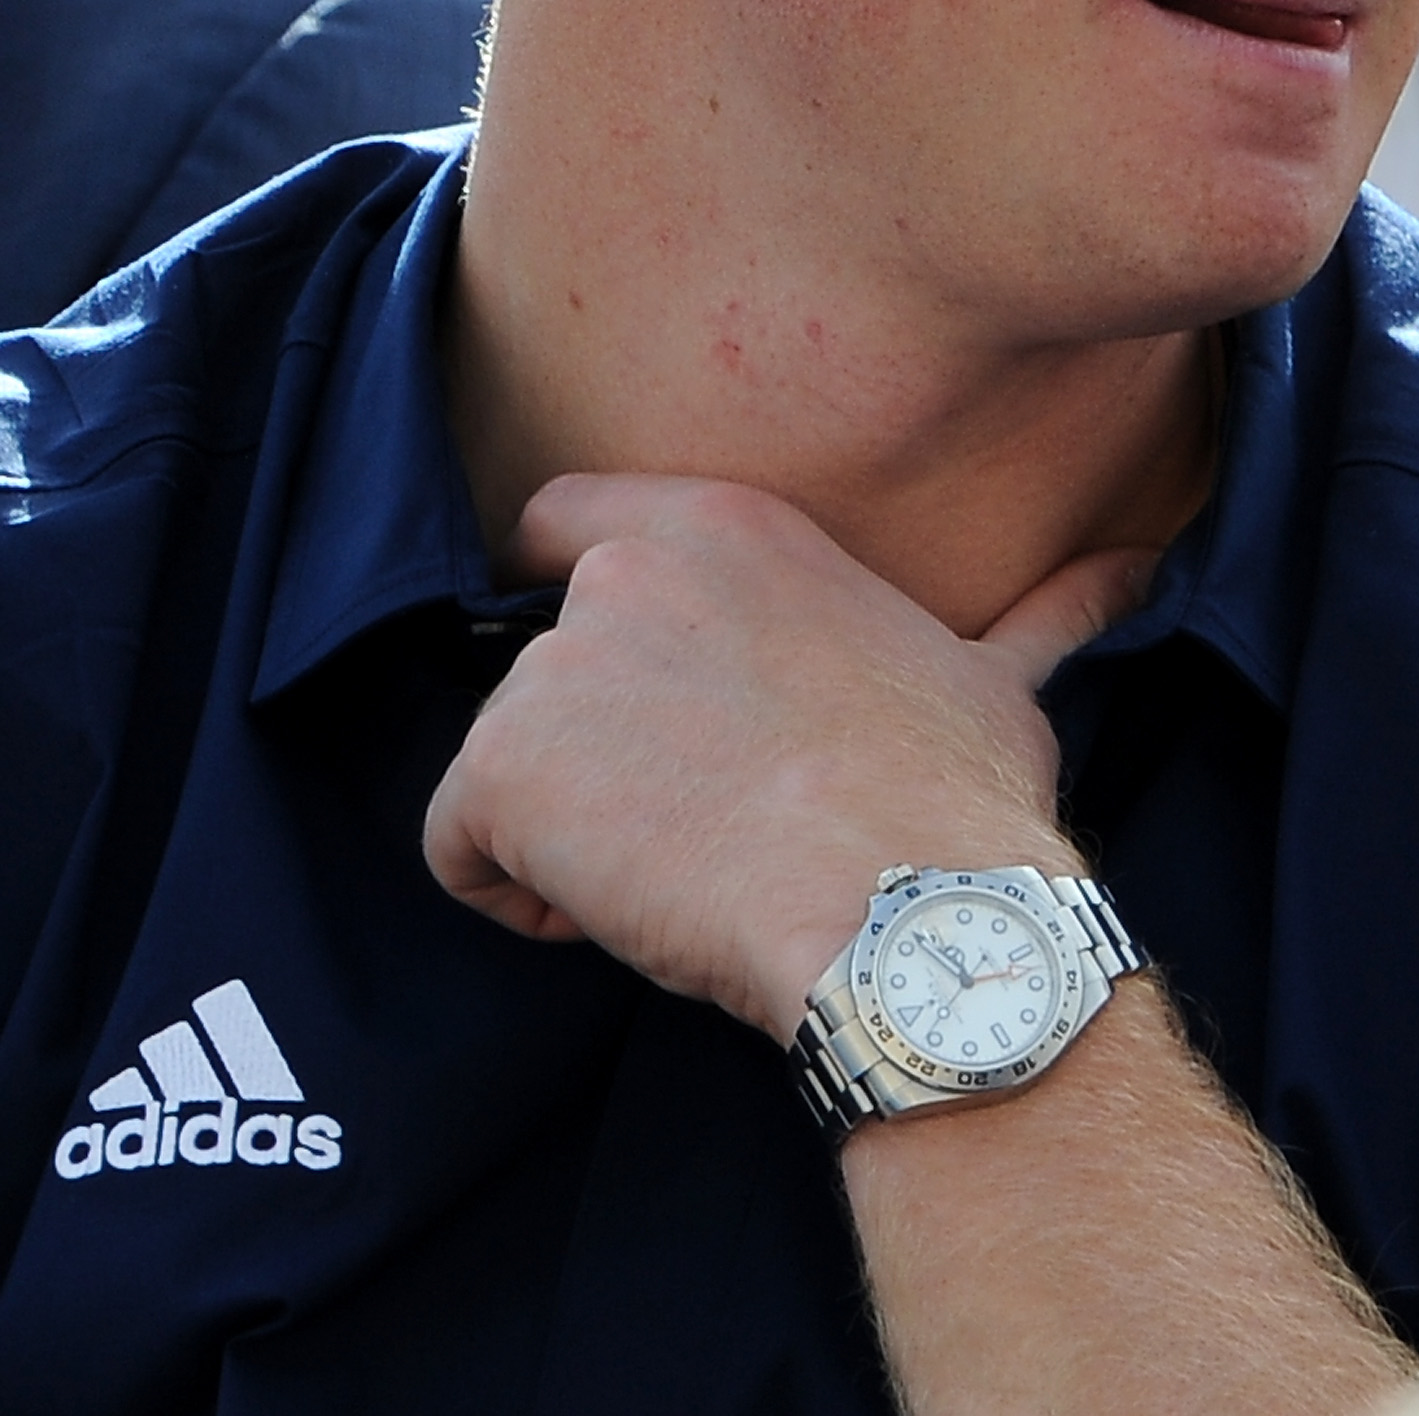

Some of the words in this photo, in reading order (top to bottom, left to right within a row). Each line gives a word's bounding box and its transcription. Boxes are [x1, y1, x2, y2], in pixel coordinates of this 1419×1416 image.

[1004, 885, 1028, 903] 10
[858, 971, 872, 985] 2
[1065, 970, 1078, 993] 14
[869, 1012, 894, 1043] 24
[1051, 1019, 1071, 1041] 16
[905, 1052, 937, 1077] 22
[1013, 1057, 1038, 1078] 18
[957, 1072, 989, 1086] 20
[55, 1097, 343, 1180] adidas
